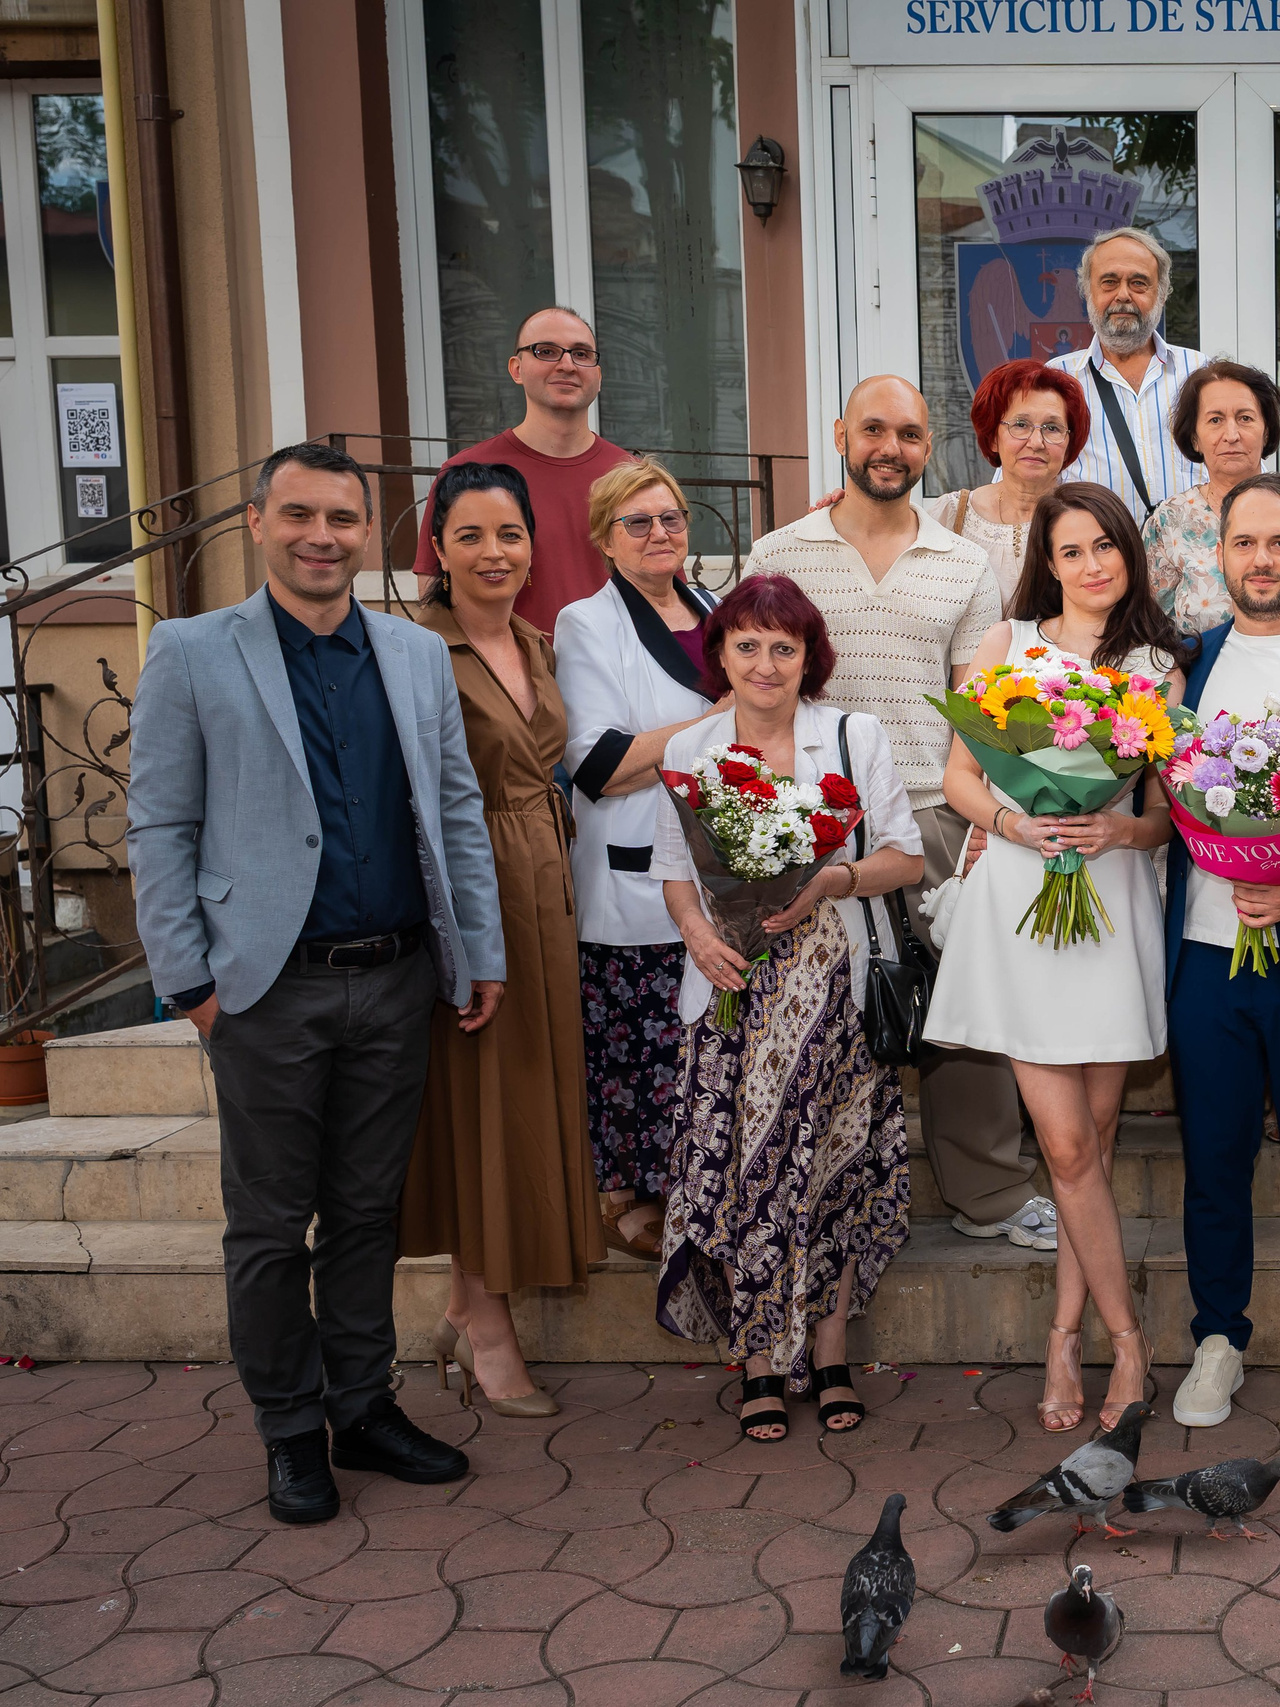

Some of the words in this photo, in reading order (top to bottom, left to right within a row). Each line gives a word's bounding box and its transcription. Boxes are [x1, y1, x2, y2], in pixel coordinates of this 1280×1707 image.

[906, 0, 1116, 34] SERVICIUL
[1127, 0, 1185, 33] DE
[1189, 836, 1233, 863] OVE
